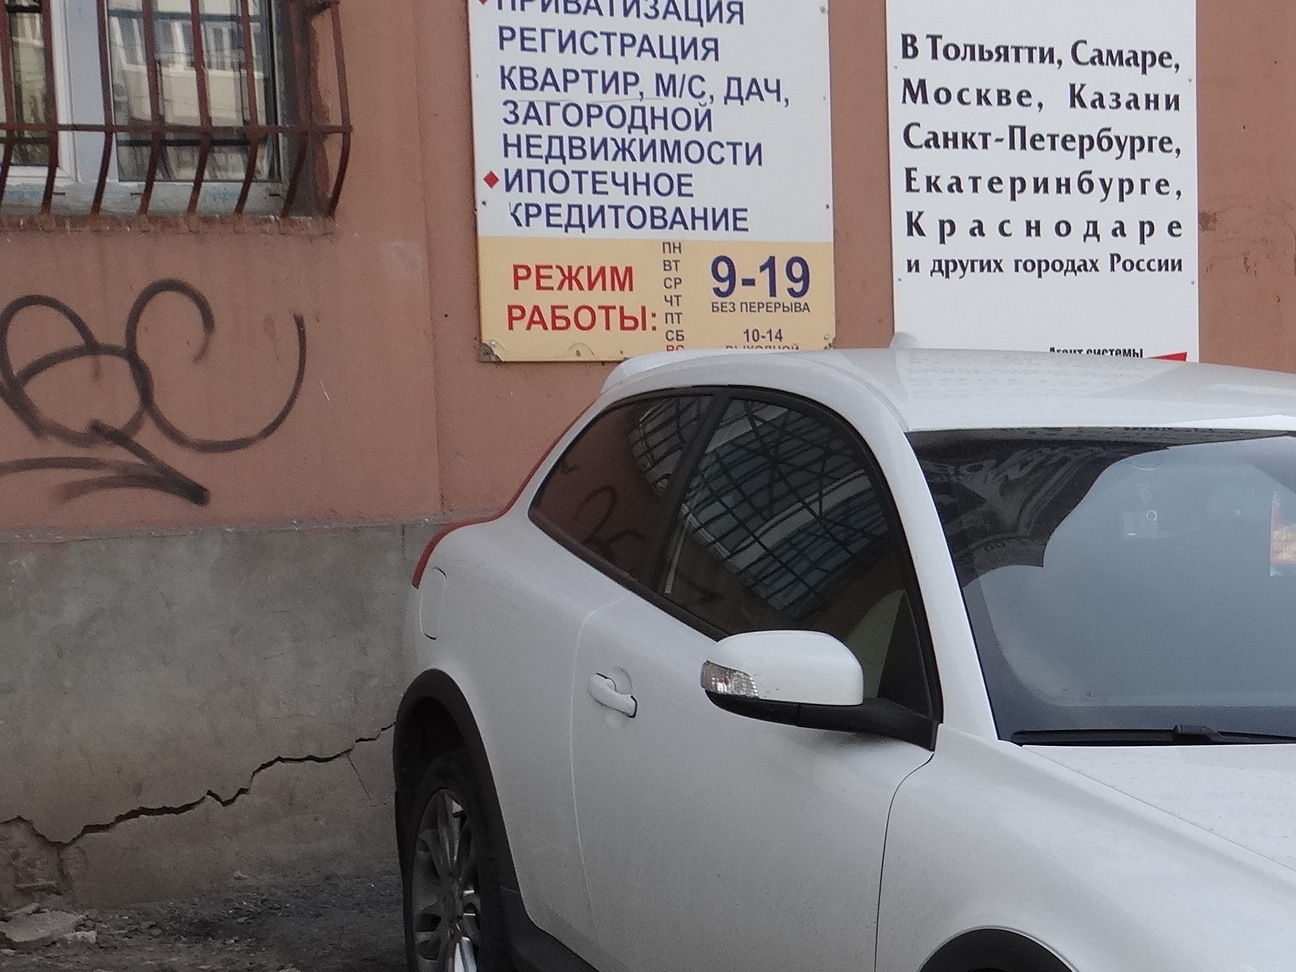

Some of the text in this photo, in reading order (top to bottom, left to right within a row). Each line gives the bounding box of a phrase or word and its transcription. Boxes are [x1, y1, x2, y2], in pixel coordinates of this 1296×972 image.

[498, 25, 720, 64] РЕГИСТРАЦИЯ
[901, 34, 1180, 75] В Тольятти, Самаре,
[500, 65, 790, 108] КВАРТИР, М/С, ДАЧ,
[901, 78, 1181, 112] Москве, Казани
[501, 100, 713, 134] ЗАГОРОДНОЙ
[502, 134, 763, 166] НЕДВИЖИМОСТИ
[903, 122, 1181, 160] Санкт-Петербурге,
[503, 168, 694, 198] ИПОТЕЧНОЕ
[904, 167, 1182, 202] Екатеринбурге,
[905, 210, 1182, 244] Краснодаре
[662, 242, 682, 254] ПН
[512, 264, 634, 292] РЕЖИМ
[663, 259, 681, 272] ВТ
[711, 255, 810, 298] 9-19
[906, 253, 1183, 278] и других городах России
[663, 277, 683, 289] СР
[664, 294, 682, 307] ЧТ
[711, 301, 811, 313] БЕЗ ПЕРЕРЫВА
[507, 304, 658, 331] РАБОТЫ:
[664, 312, 683, 325] ПТ
[665, 330, 685, 342] СБ
[743, 328, 783, 342] 10-14
